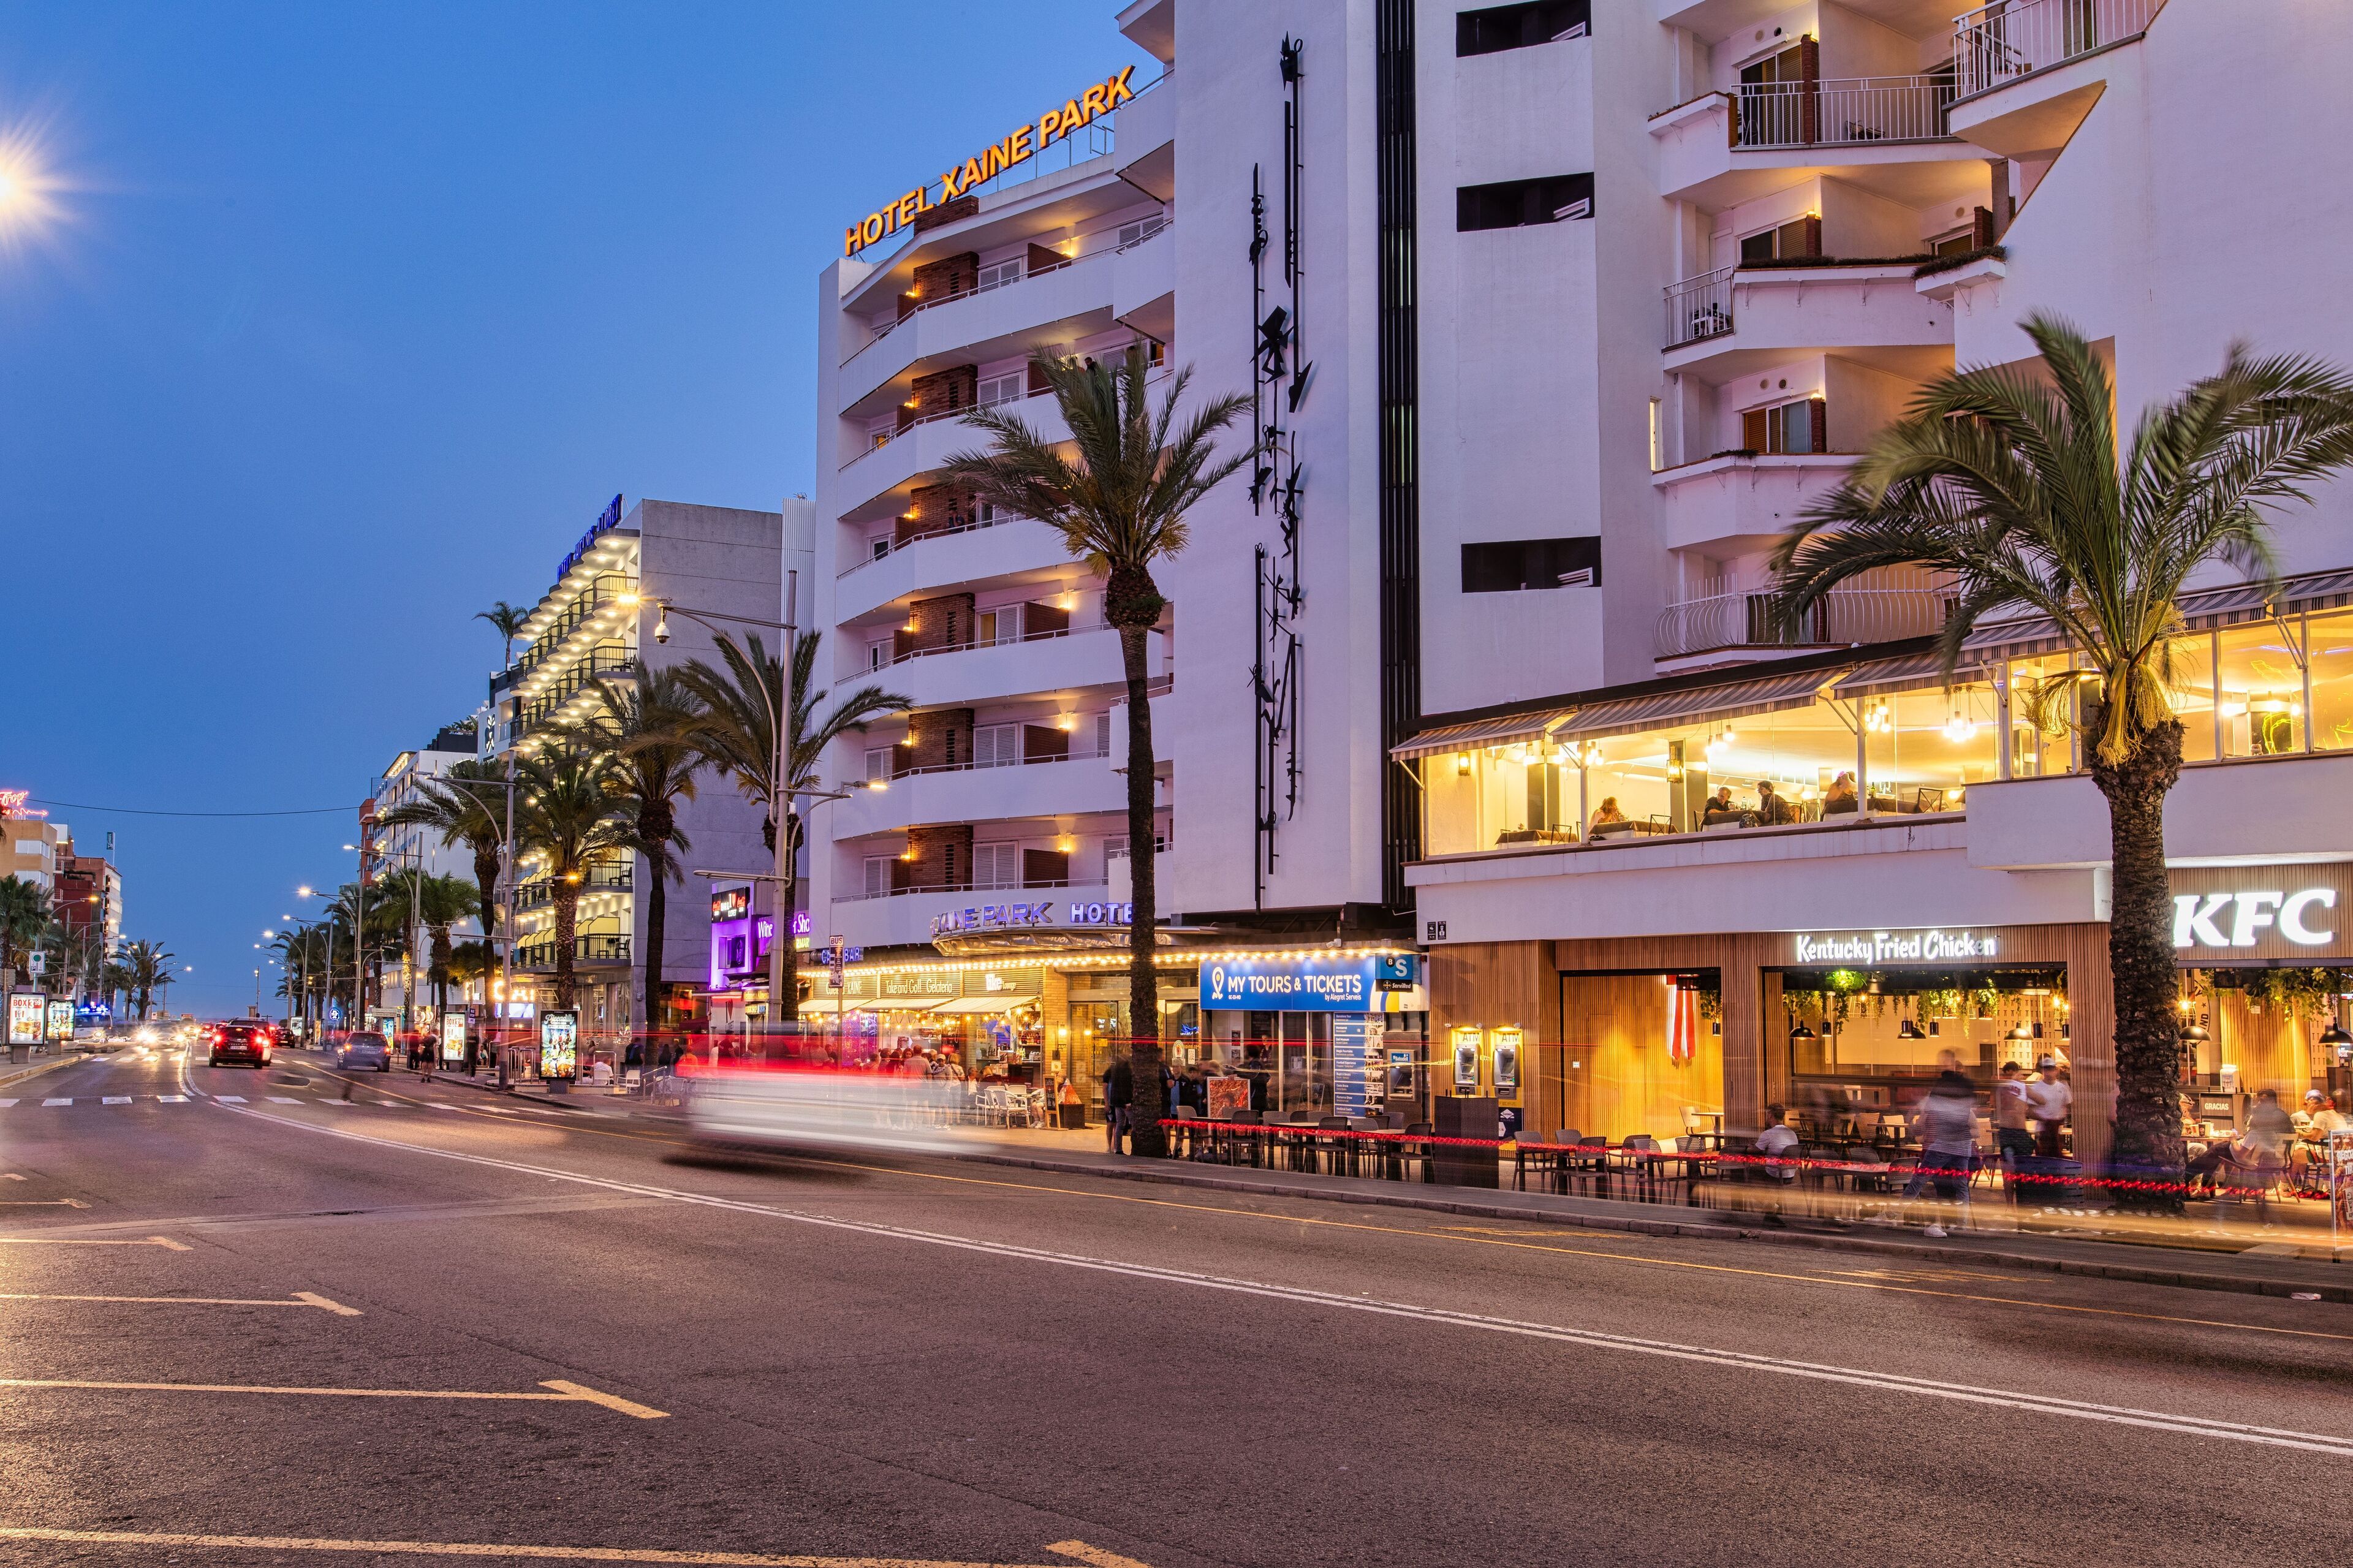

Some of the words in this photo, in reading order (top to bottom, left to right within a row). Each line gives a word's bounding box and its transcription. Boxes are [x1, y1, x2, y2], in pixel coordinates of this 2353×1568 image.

[846, 186, 936, 256] HOTEL
[939, 124, 1034, 204] XAINE
[1039, 64, 1135, 148] PARK
[798, 914, 810, 933] Sho
[983, 902, 1054, 927] PARK
[1070, 902, 1133, 923] HOTE
[2173, 889, 2340, 947] KFC
[758, 921, 773, 938] Wine
[844, 947, 860, 962] BAR
[1797, 934, 1873, 964] Kentucky
[1874, 933, 1920, 960] Fried
[1923, 930, 1996, 960] Chicken
[1395, 958, 1408, 977] S
[926, 979, 952, 993] Gelateria
[1228, 975, 1246, 993] MY
[1248, 975, 1292, 993] TOURS
[1294, 977, 1302, 991] &
[1304, 974, 1362, 993] TICKETS
[1325, 993, 1330, 1002] by
[1330, 993, 1345, 1002] Alegret
[1463, 1032, 1480, 1042] ATM
[1501, 1033, 1520, 1042] ATM
